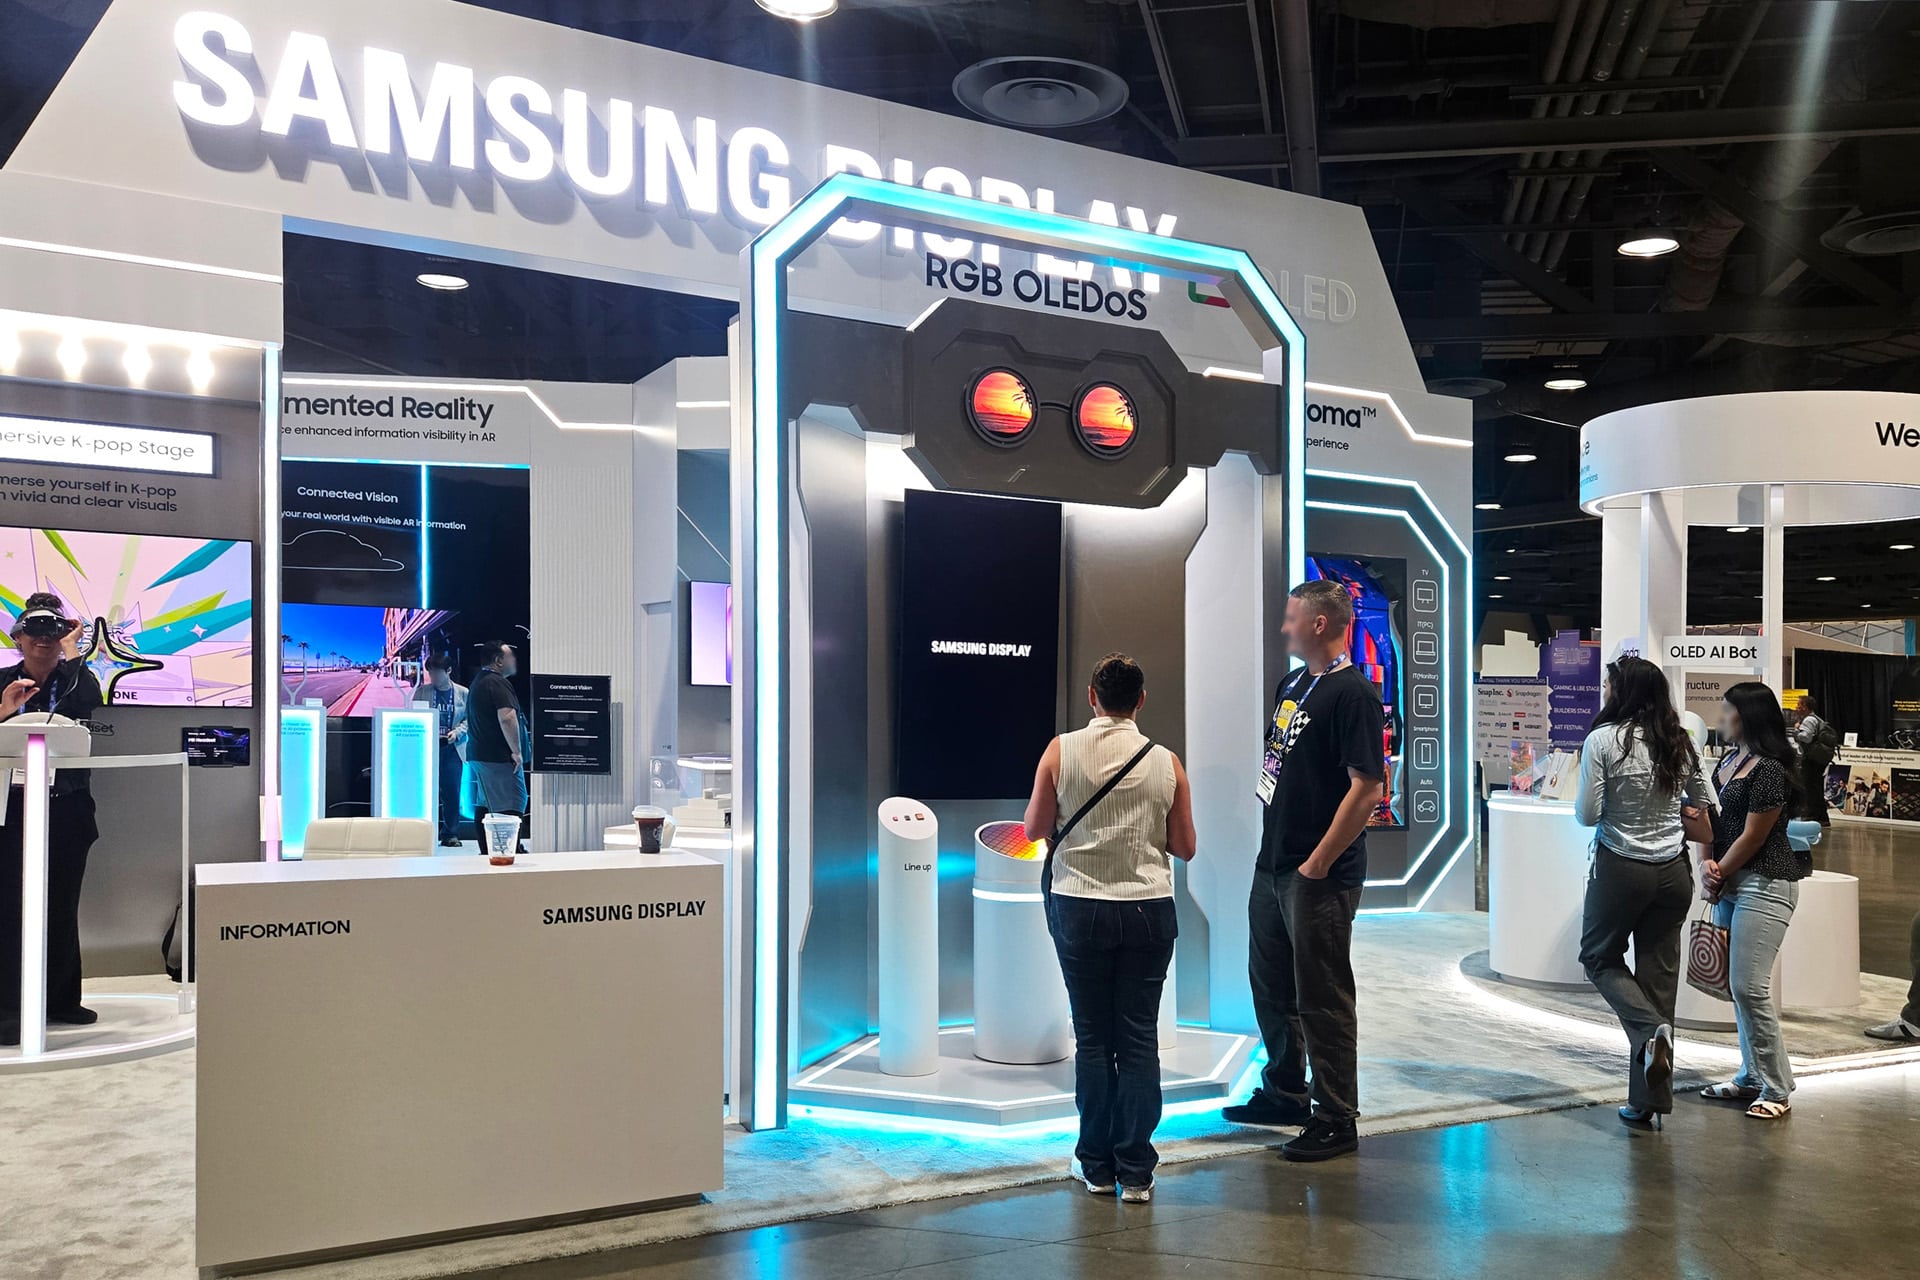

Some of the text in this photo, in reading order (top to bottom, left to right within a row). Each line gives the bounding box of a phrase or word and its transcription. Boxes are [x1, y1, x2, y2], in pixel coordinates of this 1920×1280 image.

[173, 11, 791, 226] SAMSUNG
[926, 252, 1147, 321] RGB OLEDoS
[402, 396, 494, 428] Reality
[295, 426, 351, 436] enhanced
[354, 427, 420, 440] information
[423, 429, 466, 443] visibility
[469, 431, 478, 442] in
[481, 432, 496, 442] AR
[0, 429, 195, 461] ersive K-pop Stage
[50, 479, 111, 492] yourself
[115, 482, 127, 493] in
[131, 483, 177, 499] K-pop
[297, 486, 399, 503] Connected Vision
[10, 490, 46, 503] vivid
[50, 492, 80, 505] and
[84, 495, 124, 508] clear
[128, 499, 178, 512] visuals
[303, 511, 321, 519] real
[323, 512, 350, 522] world
[352, 514, 372, 523] with
[374, 516, 401, 526] visible
[403, 518, 415, 527] AR
[1417, 621, 1433, 629] IT(PC)
[931, 640, 1031, 657] SAMSUNG DISPLAY
[1670, 646, 1757, 659] OLED AI Bot
[1478, 687, 1504, 697] Snap Inc.
[1685, 681, 1720, 690] ructure
[904, 862, 932, 873] Line up
[543, 900, 706, 925] SAMSUNG DISPLAY
[220, 920, 350, 941] INFORMATION
